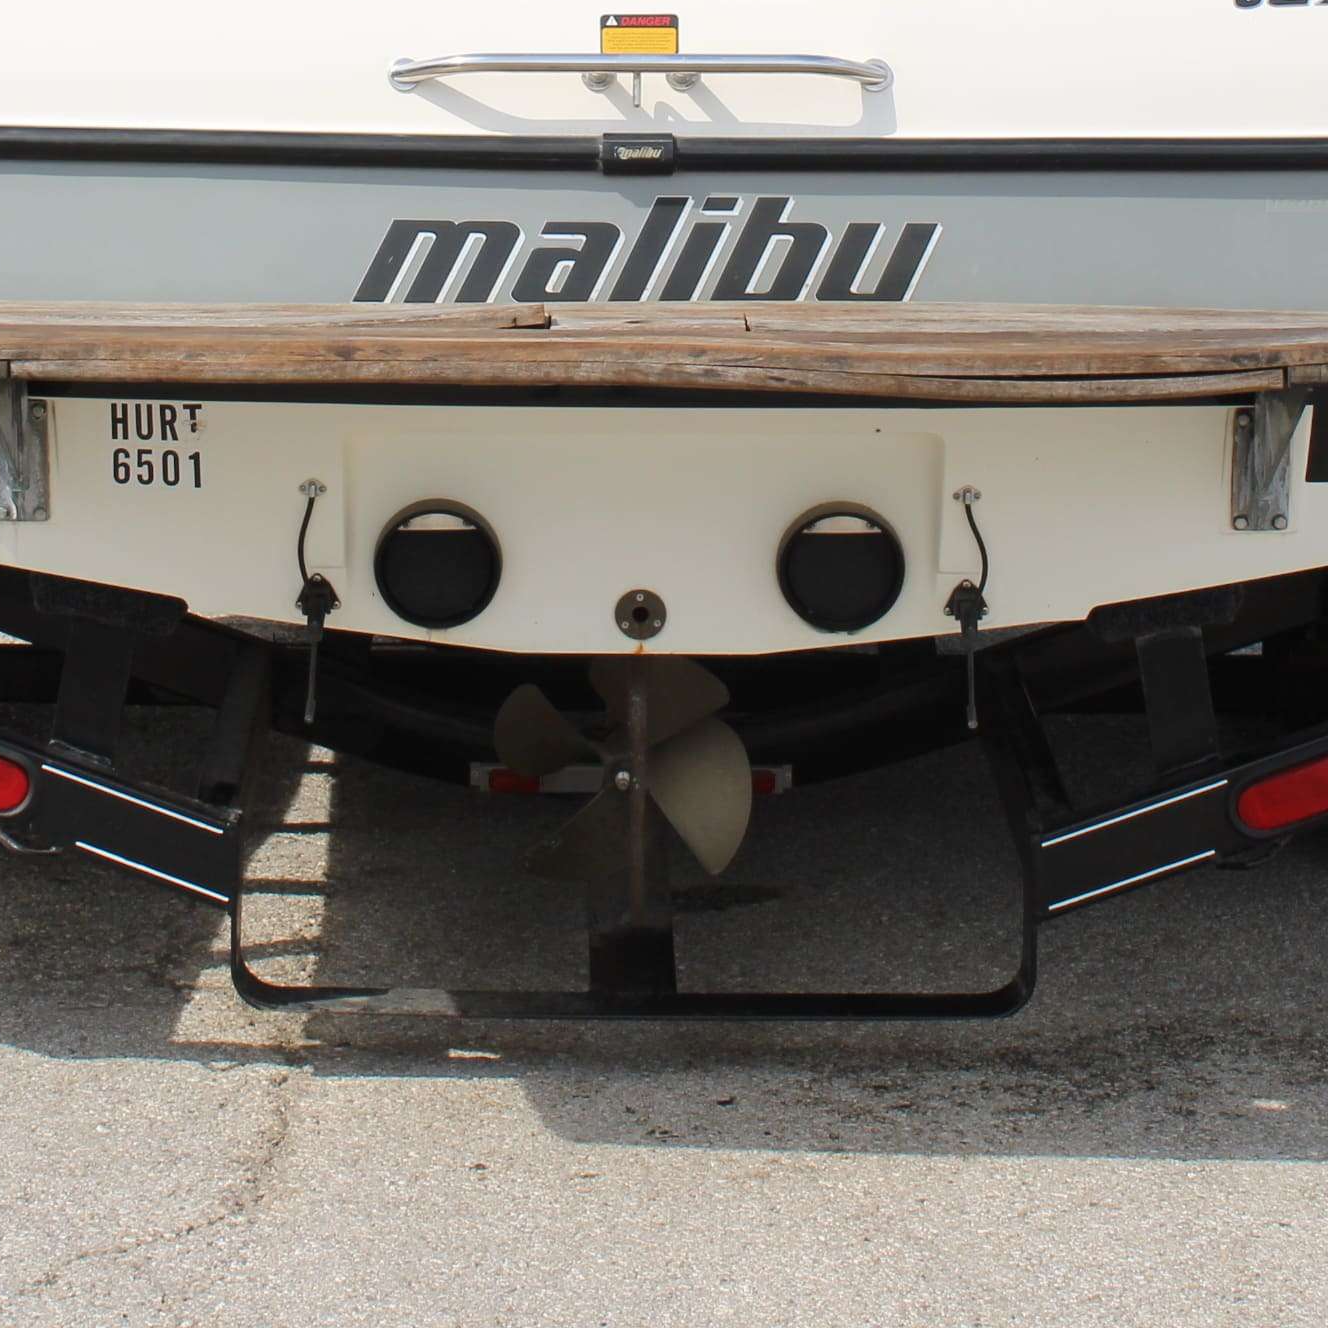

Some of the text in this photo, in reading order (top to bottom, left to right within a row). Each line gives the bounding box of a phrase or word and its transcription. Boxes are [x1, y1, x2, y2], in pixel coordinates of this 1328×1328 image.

[621, 16, 672, 27] DANGER
[352, 194, 943, 303] malibu
[110, 403, 203, 441] HURT
[112, 447, 202, 489] 6501
